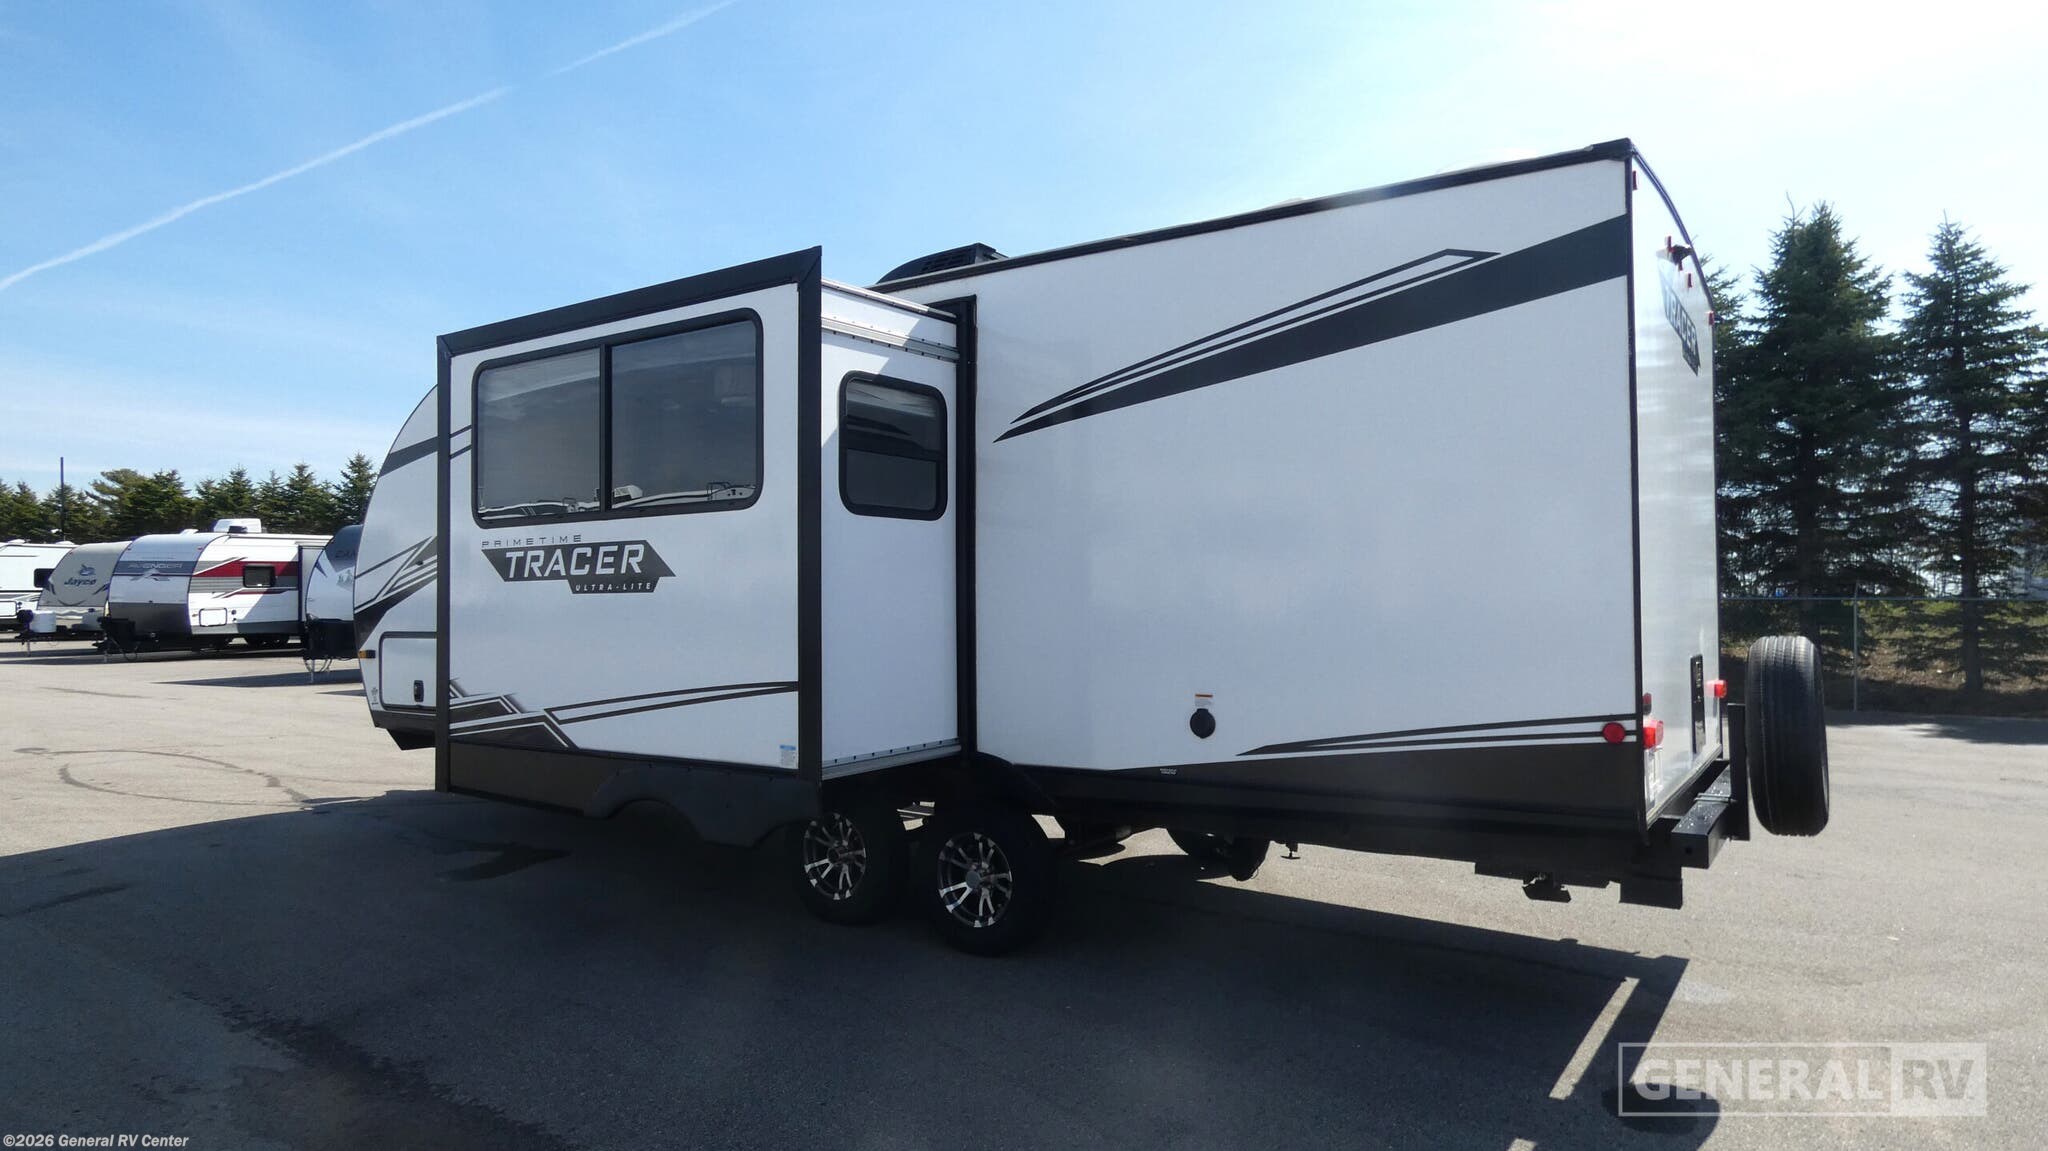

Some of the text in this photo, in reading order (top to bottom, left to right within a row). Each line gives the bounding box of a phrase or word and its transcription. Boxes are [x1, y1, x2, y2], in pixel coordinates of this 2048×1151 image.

[481, 534, 582, 548] PRIMETIME
[505, 544, 645, 579] TRACER
[63, 577, 97, 587] Jayco
[575, 582, 652, 592] ULTRA-LITE
